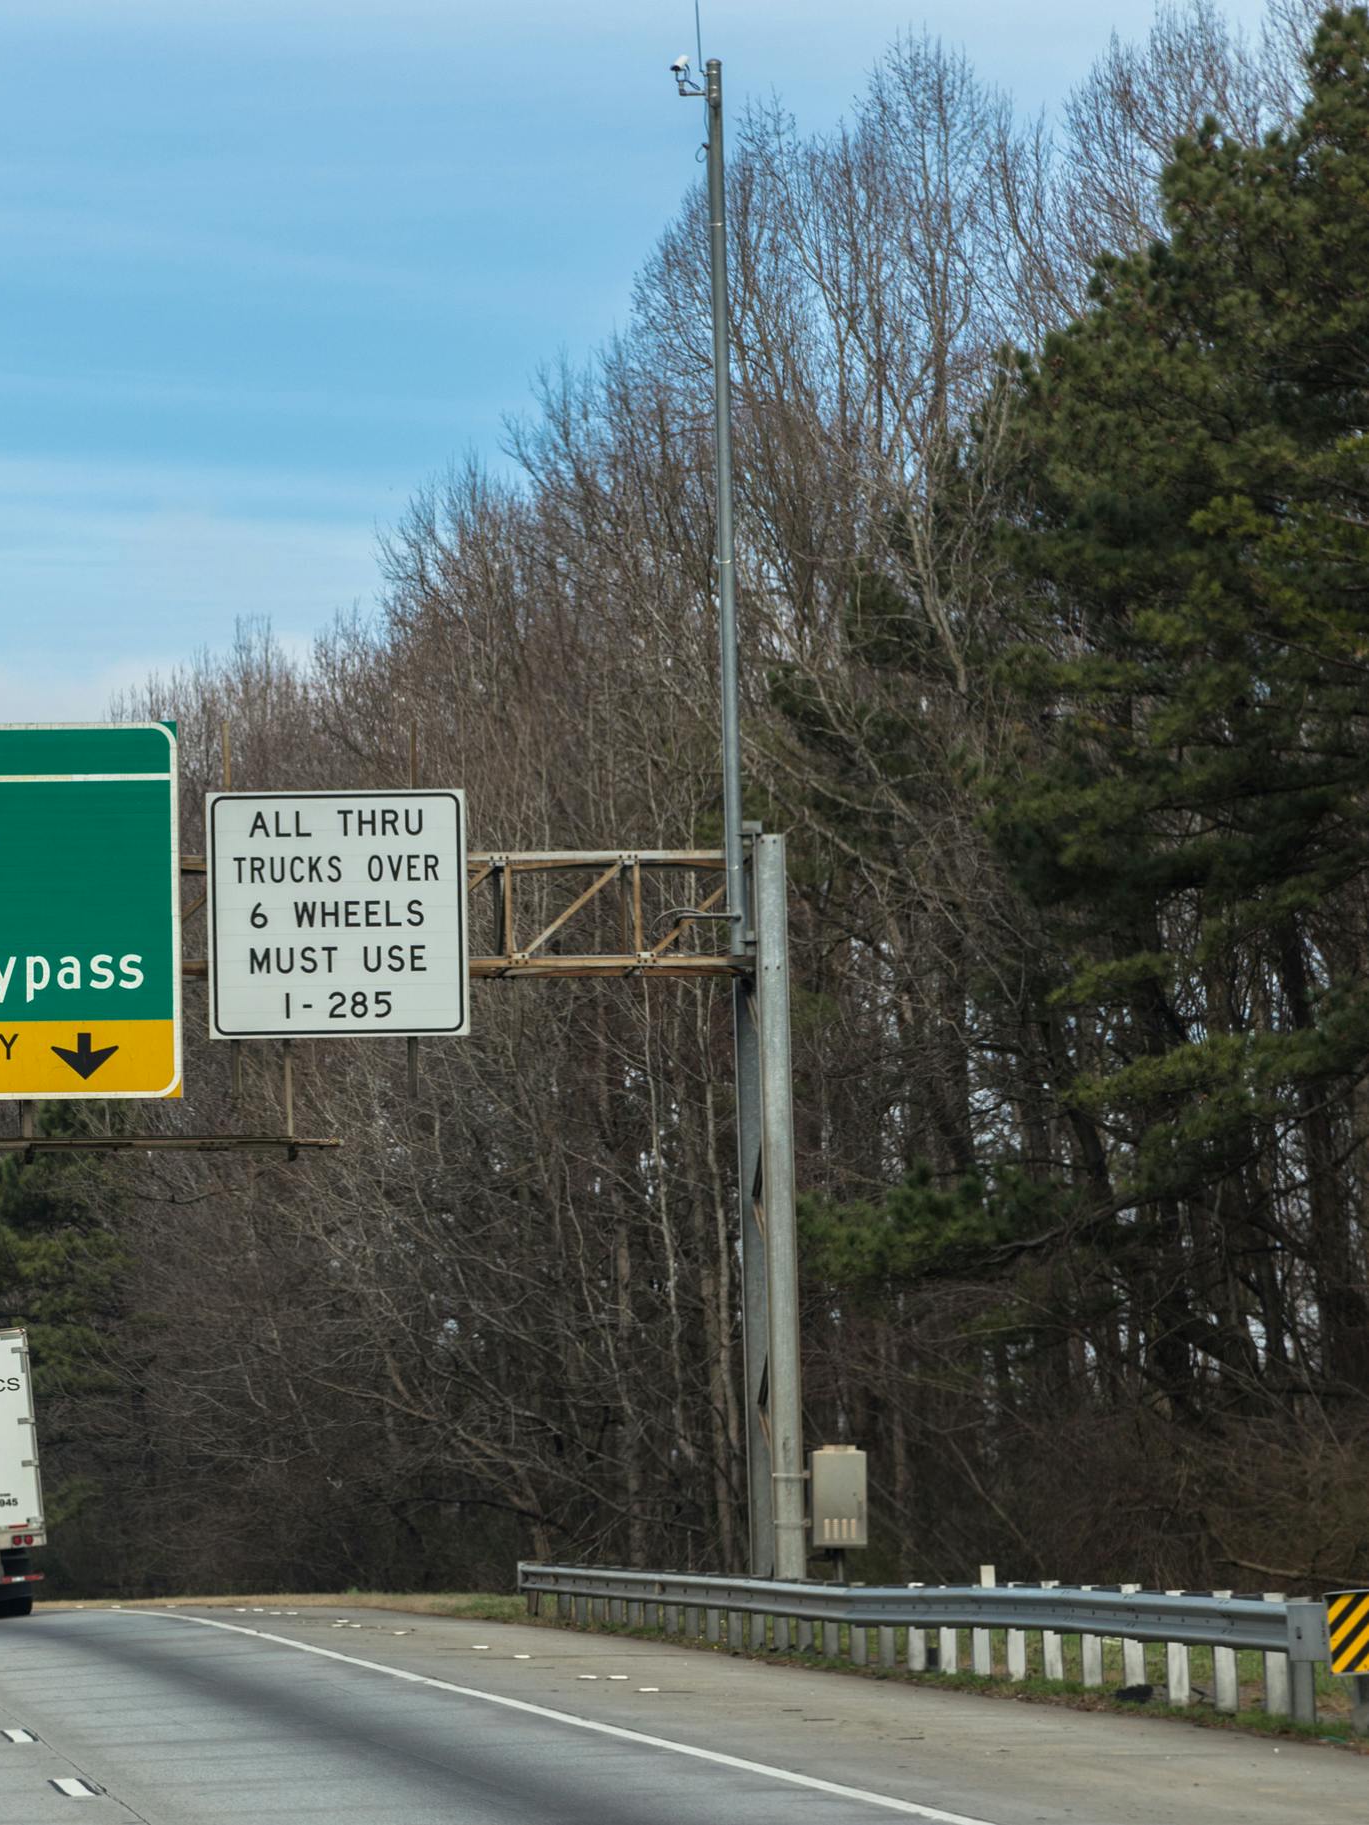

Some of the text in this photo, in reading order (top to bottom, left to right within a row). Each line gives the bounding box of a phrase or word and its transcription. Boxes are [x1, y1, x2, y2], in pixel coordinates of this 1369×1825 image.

[250, 809, 422, 837] ALL THRU
[233, 855, 438, 883] TRUCKS OVER
[251, 900, 424, 928] 6 WHEELS
[250, 945, 426, 974] MUST USE
